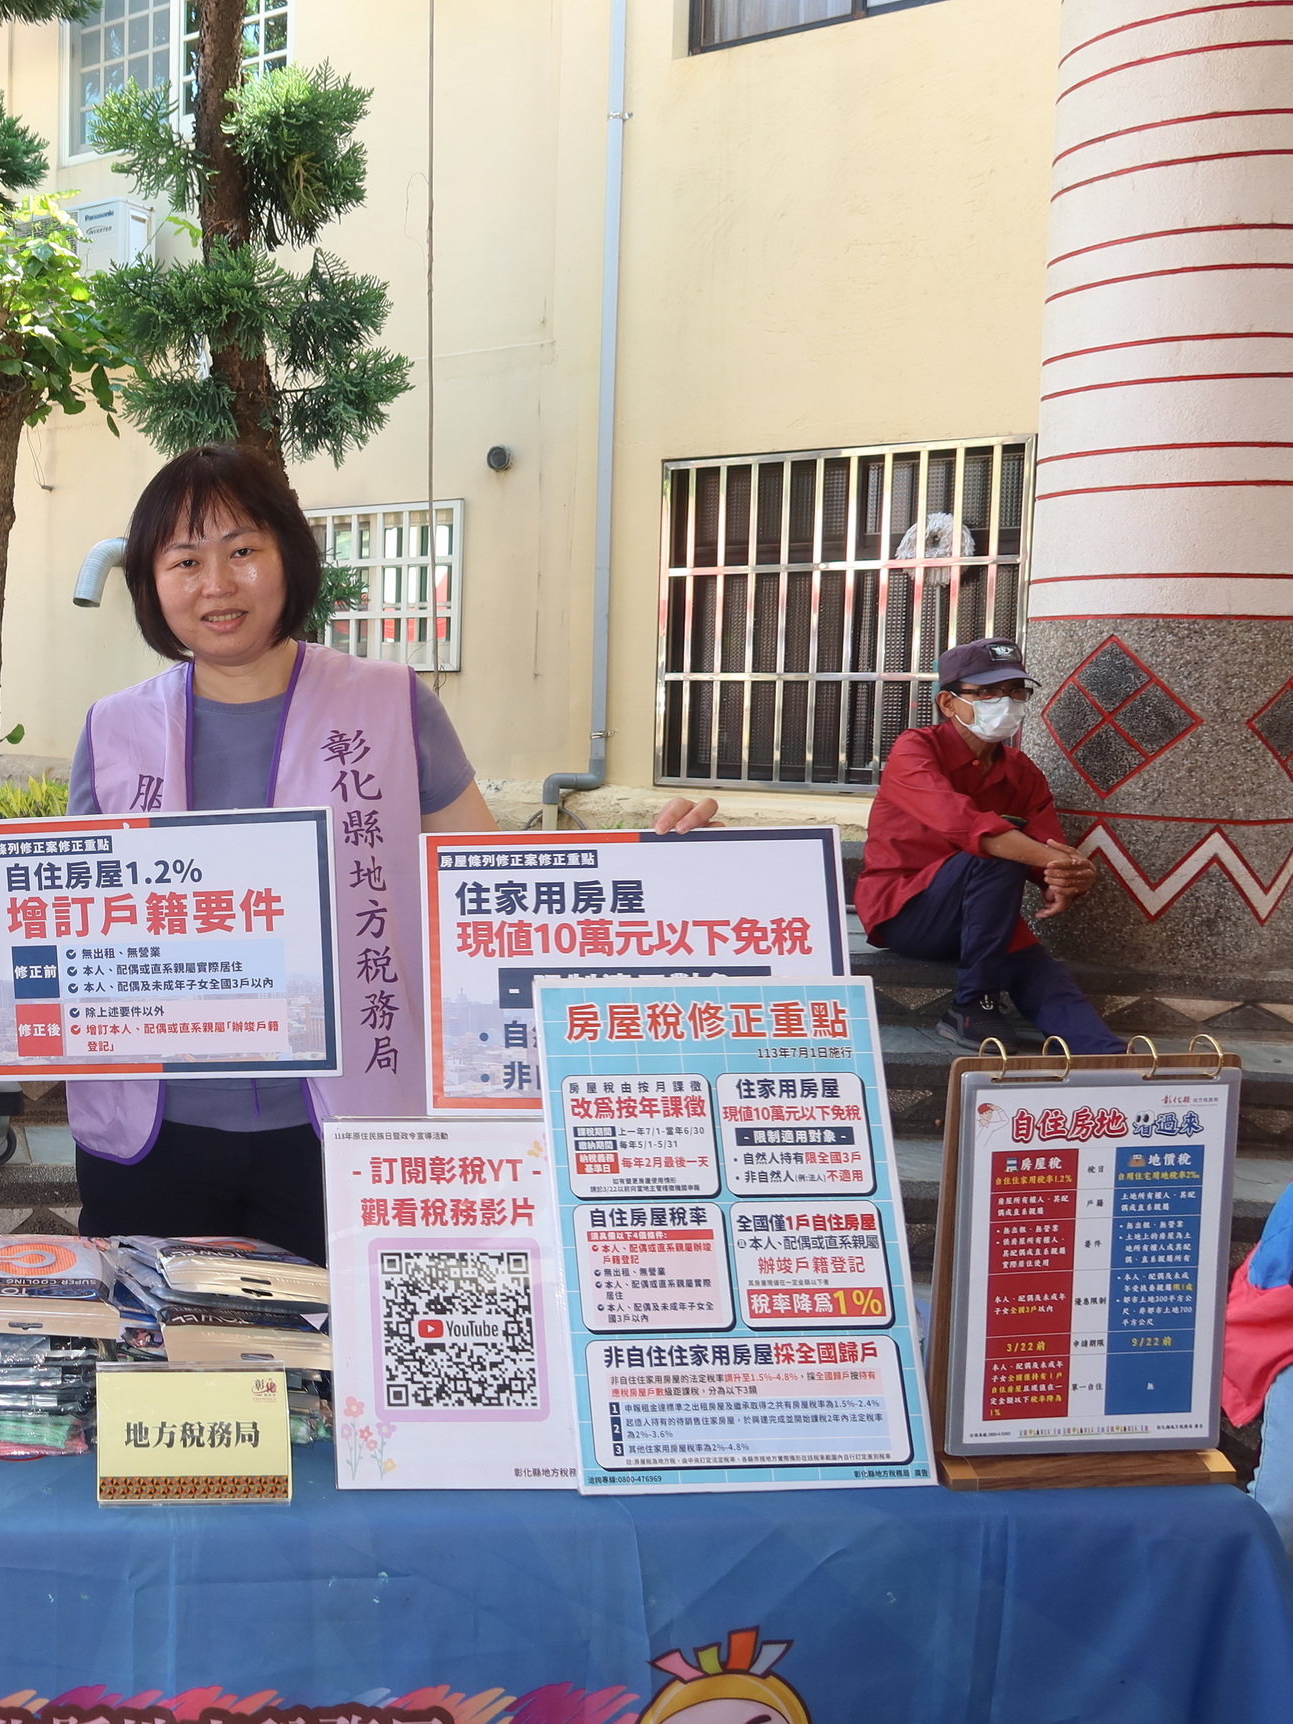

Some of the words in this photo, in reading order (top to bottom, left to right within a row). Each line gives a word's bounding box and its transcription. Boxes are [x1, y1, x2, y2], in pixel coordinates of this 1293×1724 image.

[85, 210, 114, 221] Panasonic
[439, 852, 595, 868] 房屋條列修正案修正重點
[6, 858, 203, 892] 自住房屋1.2%
[455, 879, 646, 916] 住家用房屋
[7, 888, 285, 939] 增訂戶籍要件
[82, 947, 161, 959] 無出租、無營業
[14, 965, 57, 979] 修正前
[83, 961, 243, 976] 本人、配偶或直系親屬實際居住
[84, 977, 274, 993] 本人、配偶及未成年子女全國3戶以內
[85, 1006, 165, 1018] 除上述要件以外
[566, 1001, 849, 1041] 房屋稅修正重點
[18, 1023, 61, 1037] 修正後
[504, 1020, 537, 1048] 自
[758, 1047, 853, 1059] 113年7月1日施行
[503, 1061, 540, 1090] 非
[569, 1081, 702, 1094] 房屋稅由按月課徵
[735, 1078, 840, 1099] 住家用房屋
[1011, 1107, 1128, 1143] 自住房地
[622, 1156, 709, 1168] 每年2月最後一天
[743, 1151, 861, 1165] 自然人持有限全國3戶
[1021, 1157, 1062, 1171] 房屋稅
[1148, 1153, 1192, 1166] 地價稅
[360, 1198, 535, 1227] 觀看稅務影片
[590, 1206, 707, 1228] 自住房屋稅率
[736, 1213, 876, 1232] 全國僅1戶自住房屋
[603, 1255, 639, 1264] 戶籍登記
[758, 1256, 866, 1274] 辦竣戶籍登記
[606, 1291, 623, 1300] 居住
[608, 1314, 649, 1323] 國3戶以內
[446, 1320, 499, 1337] YouTube
[1007, 1341, 1046, 1352] 3/22前
[1132, 1336, 1172, 1347] 9/22前
[603, 1341, 879, 1368] 非自住住家用房屋採全國歸戶
[612, 1404, 618, 1413] 1
[125, 1421, 260, 1448] 地方稅務局
[614, 1424, 620, 1434] 2
[615, 1444, 622, 1455] 3
